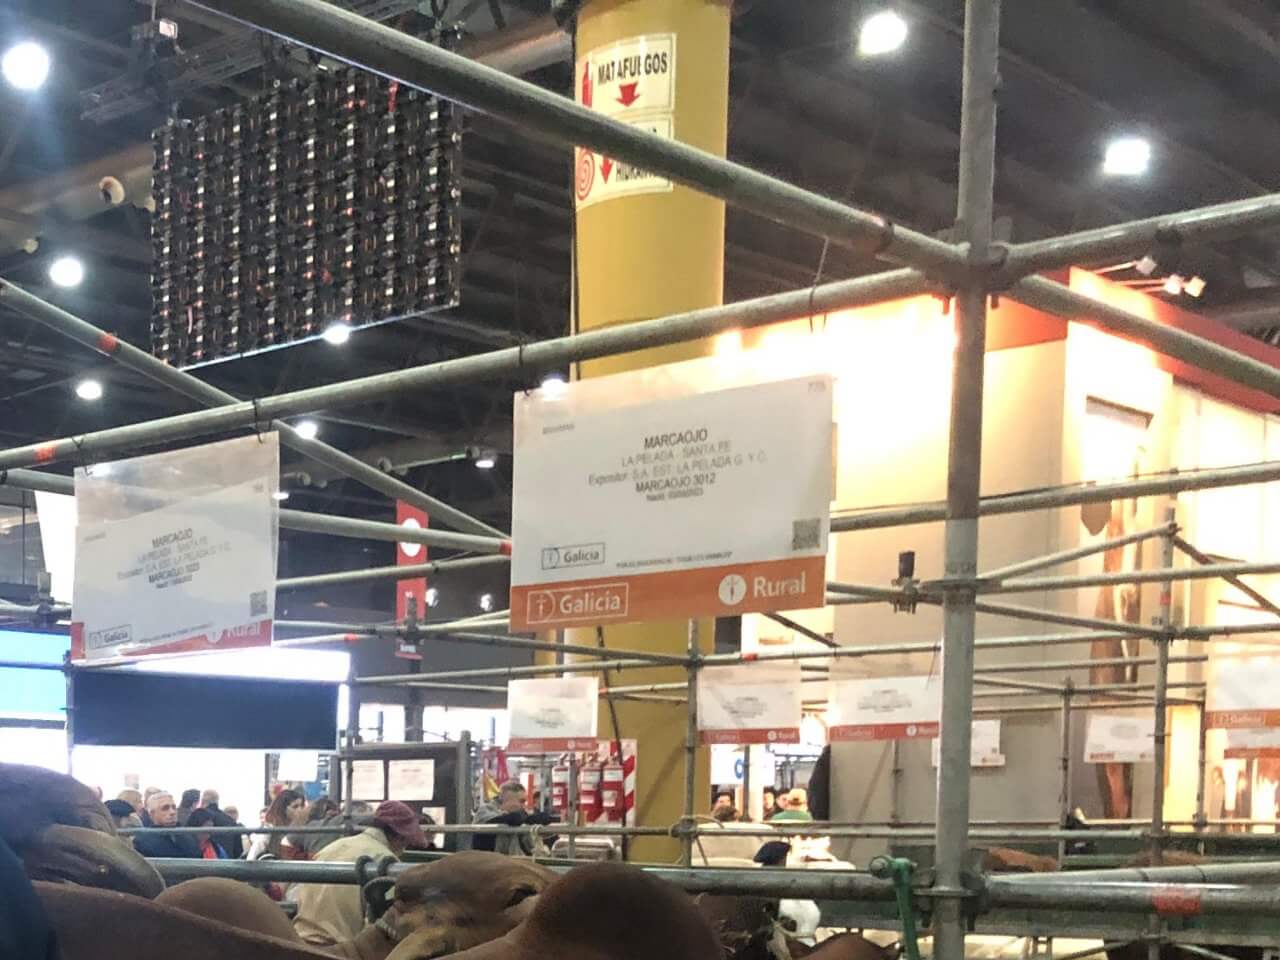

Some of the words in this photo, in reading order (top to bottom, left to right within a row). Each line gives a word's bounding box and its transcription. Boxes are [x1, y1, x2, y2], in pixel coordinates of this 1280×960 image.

[644, 428, 708, 449] MARCAOJO
[636, 475, 691, 493] MARCAOJO
[563, 550, 600, 564] Galicia
[753, 572, 806, 598] Rural
[559, 591, 621, 614] Galicia
